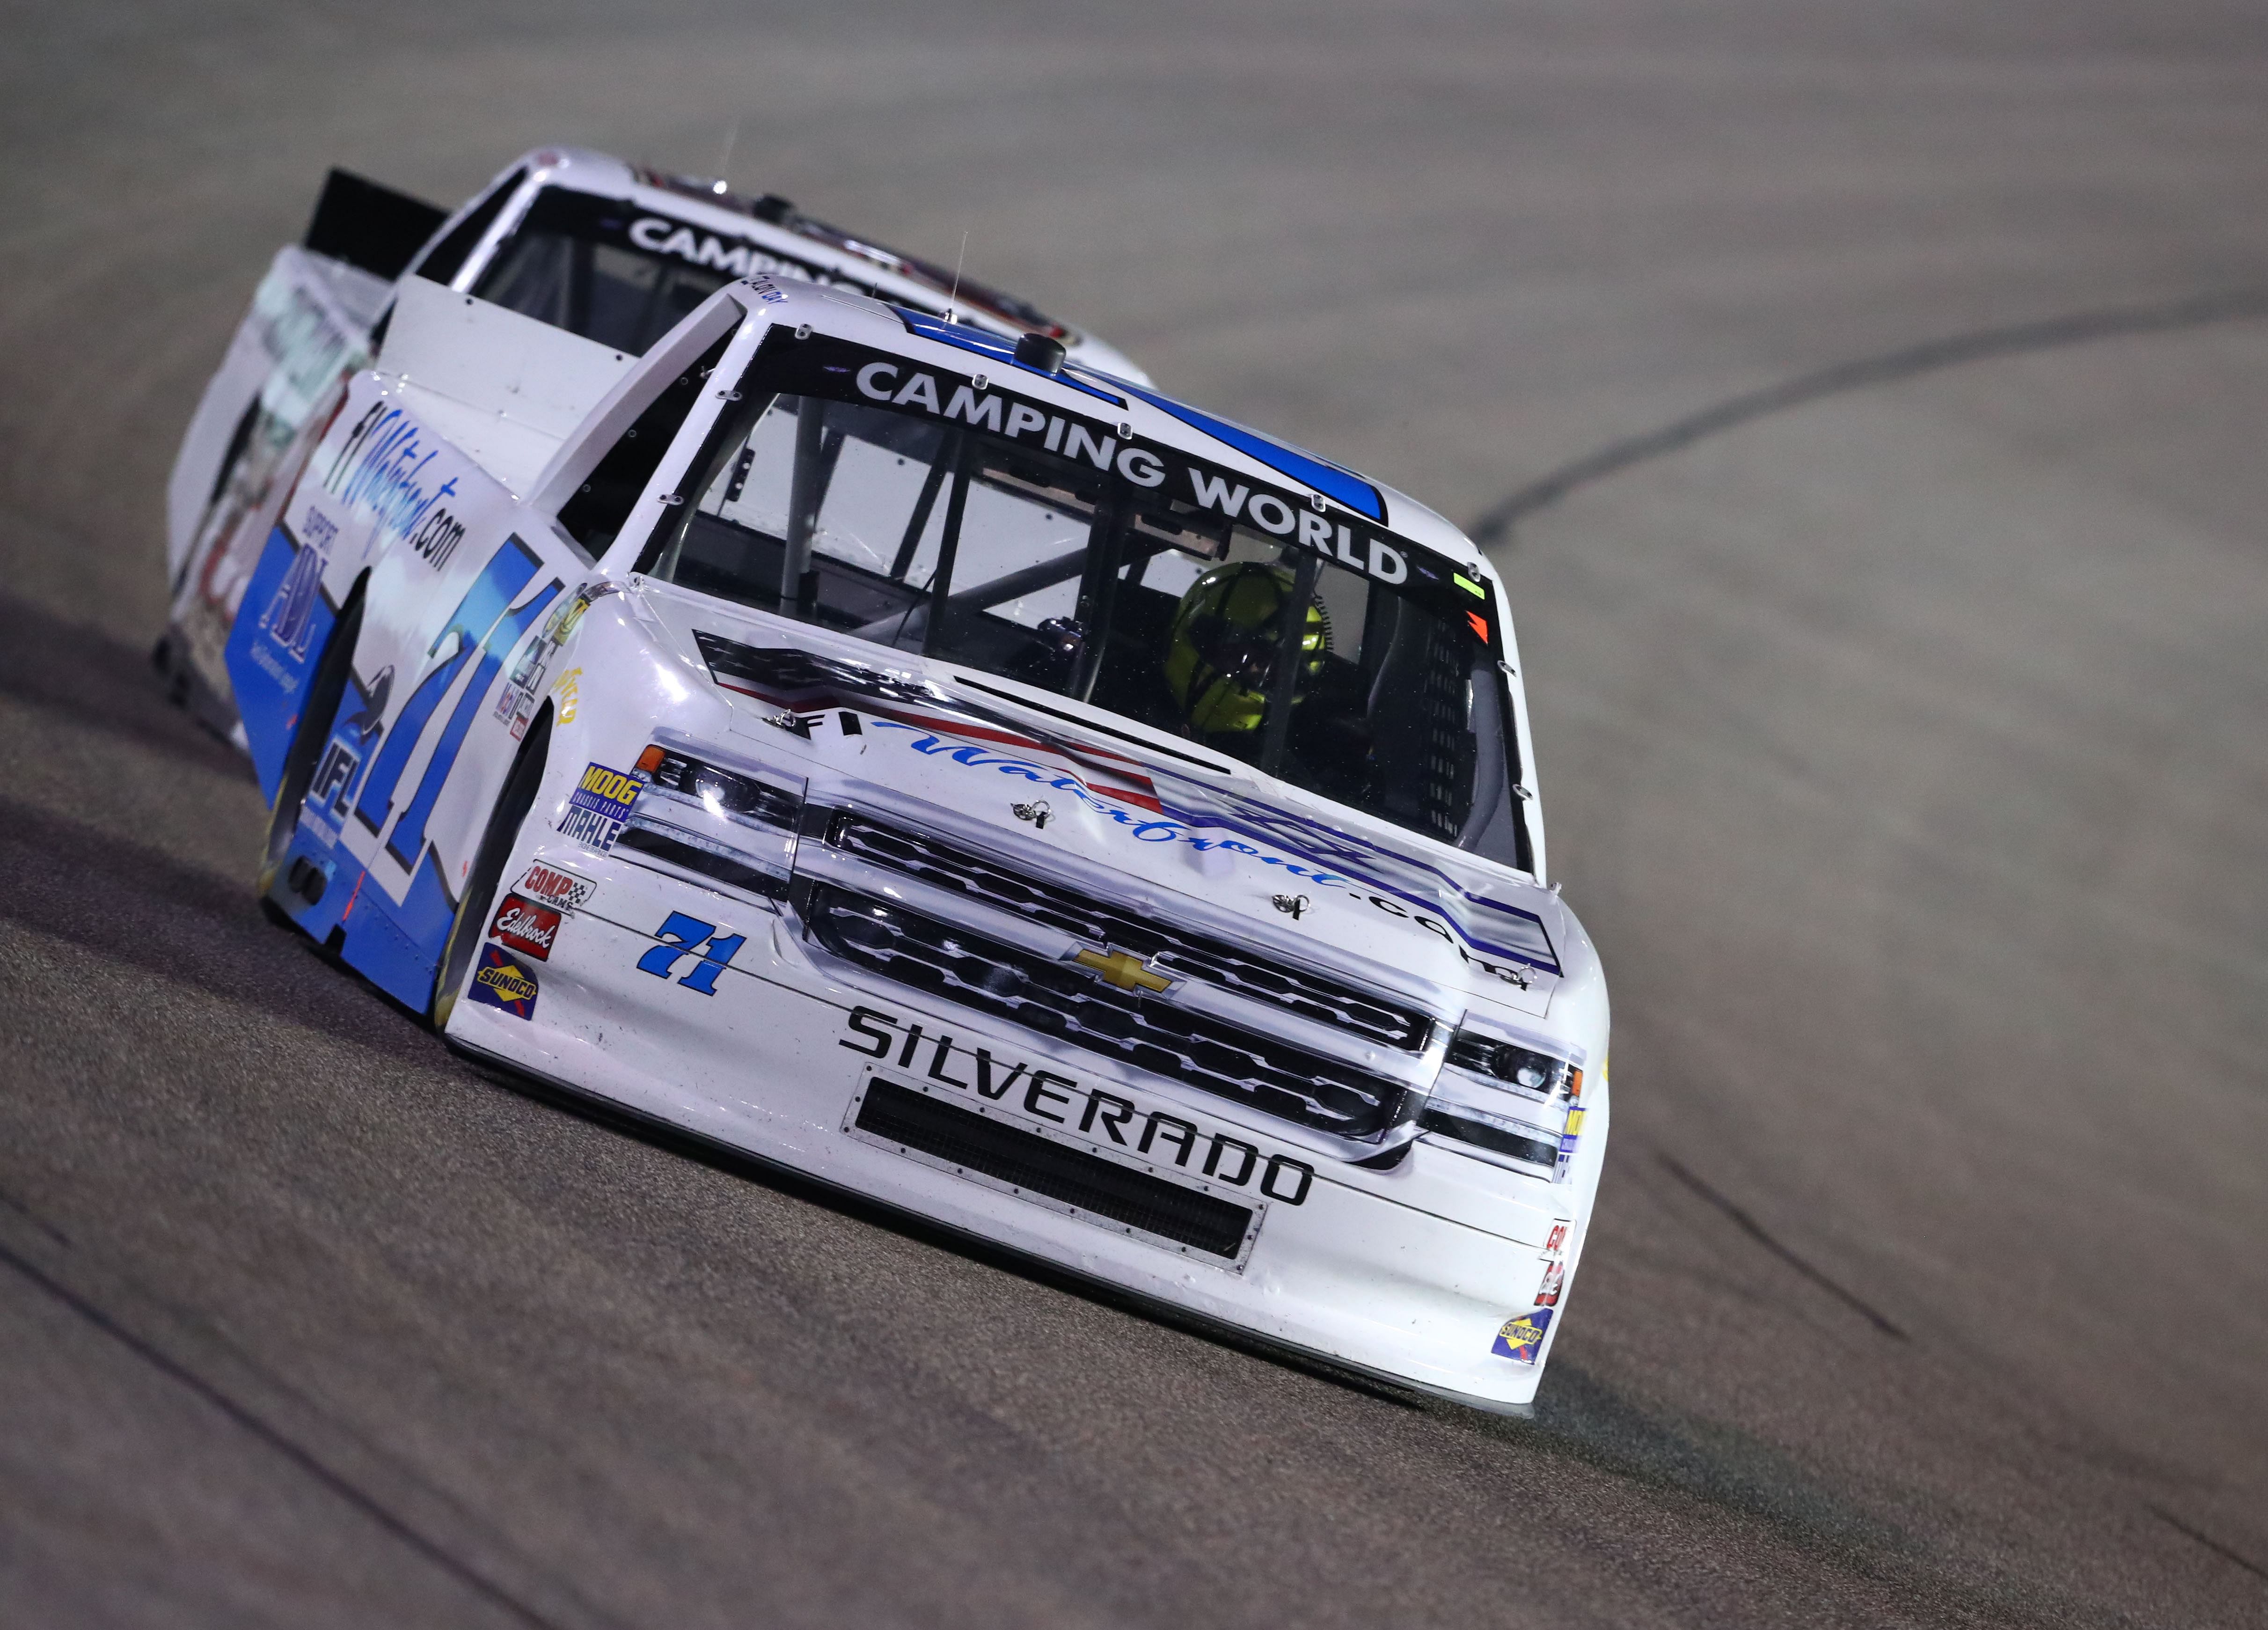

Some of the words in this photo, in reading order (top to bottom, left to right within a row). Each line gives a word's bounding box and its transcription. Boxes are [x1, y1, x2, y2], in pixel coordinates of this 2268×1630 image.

[761, 291, 789, 304] DAY
[856, 361, 1165, 487] CAMPING
[1188, 467, 1408, 585] WORLD
[354, 532, 566, 876] 71
[578, 765, 644, 806] MOOG
[556, 805, 622, 852] MAHLE
[524, 866, 573, 897] COMP
[547, 894, 573, 910] CAMS
[497, 907, 556, 948] Edelbrock
[636, 910, 747, 997] 71
[479, 968, 535, 999] SUNOCO
[839, 1005, 1315, 1206] SILVERADO
[1500, 1324, 1540, 1344] SUNOCO
